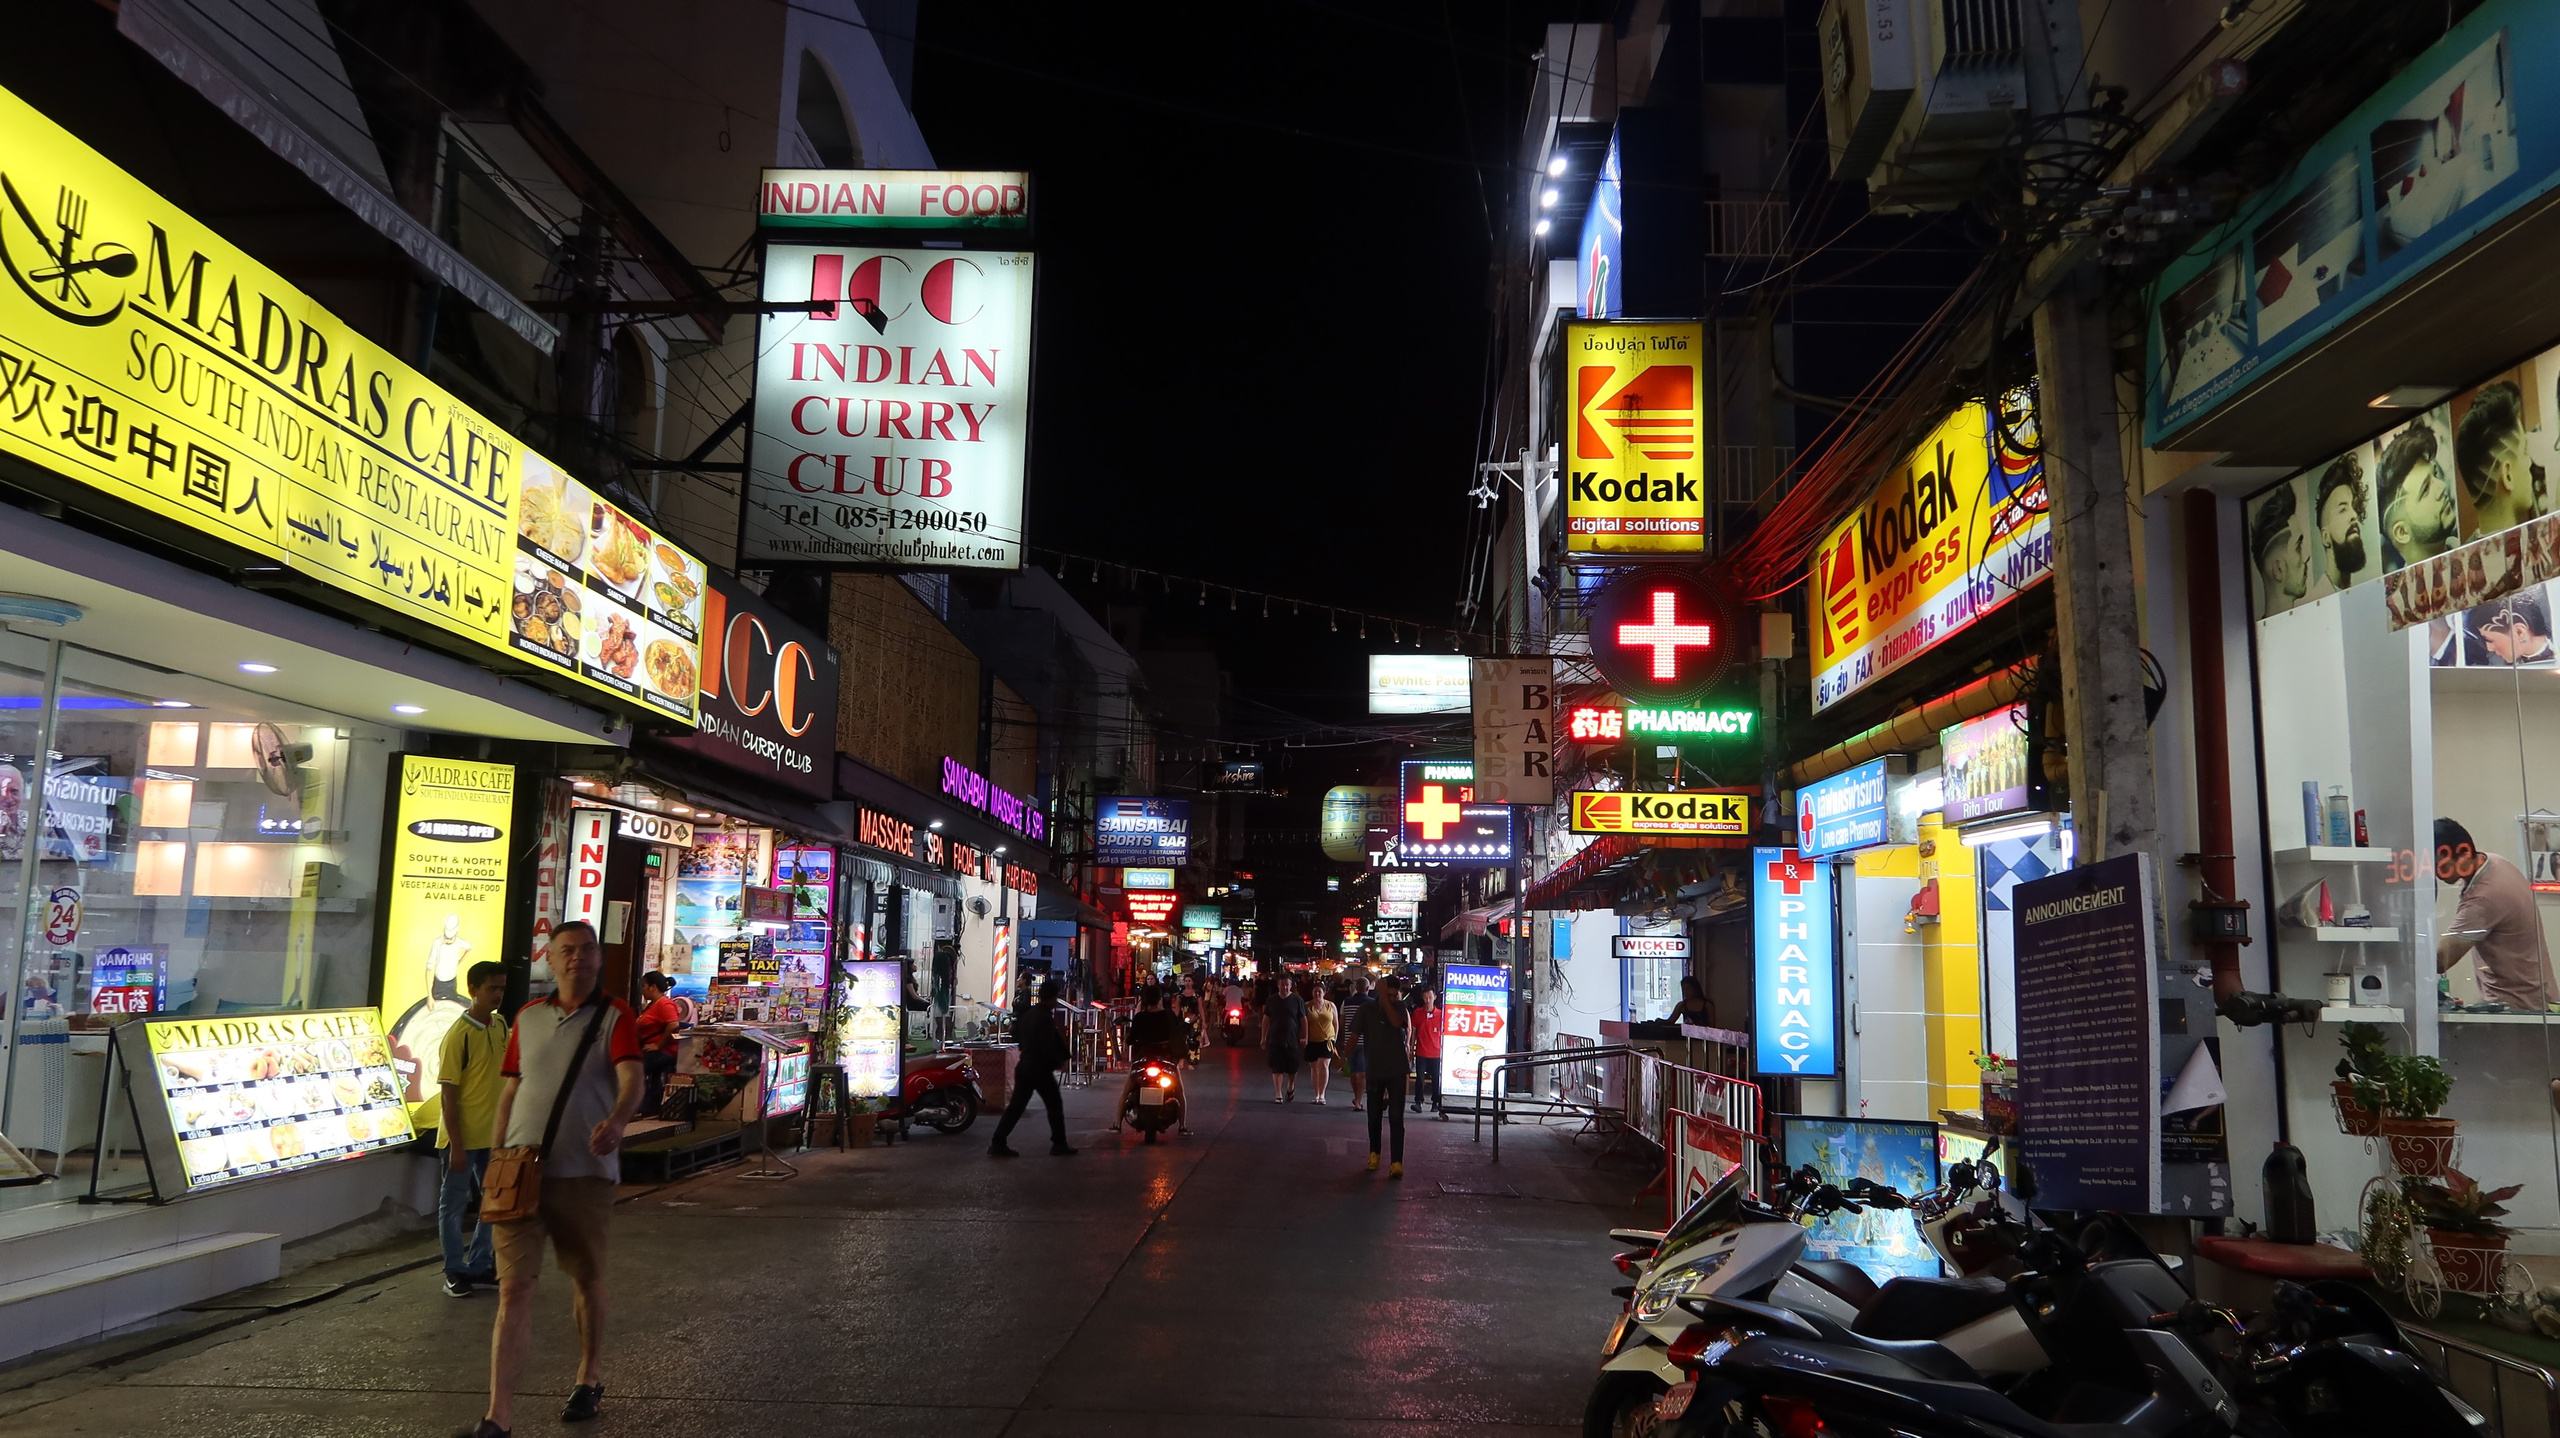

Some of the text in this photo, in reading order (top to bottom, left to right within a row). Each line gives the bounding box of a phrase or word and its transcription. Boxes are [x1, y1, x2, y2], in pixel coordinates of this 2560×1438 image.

[762, 182, 1026, 217] INDIAN FOOD
[809, 254, 986, 326] ICC
[1583, 333, 1690, 354] ป๊อปปูล่า โฟโต้
[137, 220, 511, 508] MADRAS CAFE
[787, 342, 1001, 389] INDIAN
[790, 395, 997, 443] CURRY
[0, 350, 275, 531] 欢迎中国人
[127, 329, 506, 565] SOUTH INDIAN RESTAURANT
[787, 453, 954, 498] CLUB
[1571, 471, 1699, 502] Kodak
[780, 504, 987, 534] Tel 085-1200050
[1858, 438, 1959, 585] Kodak
[1571, 517, 1700, 534] digital solutions
[768, 535, 1006, 562] www.indiancurryclubphuket.com
[1865, 525, 1960, 623] express
[606, 588, 627, 604] SAMOSA
[519, 638, 540, 653] NORTH
[590, 668, 634, 693] TANDOORI CHICKEN
[1855, 653, 1873, 686] FAX
[1477, 660, 1512, 801] WICKED
[1521, 684, 1550, 778] BAR
[1571, 708, 1624, 739] 药店
[1627, 708, 1753, 734] PHARMACY
[696, 709, 813, 774] NDIAN CURRY CLUB
[422, 766, 512, 790] MADRAS CAFE
[1425, 766, 1473, 780] PHARMA
[420, 788, 511, 805] SOUTH INDIAN RESTAURANT
[942, 755, 990, 812] SANSABAI
[990, 783, 1023, 831] MASSAGE
[1032, 810, 1044, 841] SPA
[1631, 796, 1741, 821] Kodak
[1962, 797, 2004, 819] Rita Tour
[1098, 817, 1188, 834] SANSABAI
[1327, 809, 1359, 823] DIVE
[1671, 822, 1698, 831] digital
[1699, 822, 1740, 831] solutions
[418, 822, 495, 839] 24 HOURS OPEN
[859, 807, 915, 858] MASSAGE
[926, 831, 945, 867] SPA
[953, 841, 978, 877] FACIAL
[1097, 834, 1187, 848] SPORTS BAR
[1821, 818, 1882, 849] Love care Pharmacy
[409, 854, 502, 866] SOUTH & NORTH
[424, 866, 496, 877] INDIAN FOOD
[646, 853, 661, 867] OPEN
[400, 881, 450, 890] VEGETARIAN
[460, 883, 478, 891] JAIN
[480, 884, 501, 892] FOOD
[1143, 875, 1166, 886] PADI
[425, 892, 486, 902] AVAILABLE
[2025, 885, 2126, 924] ANNOUNCEMENT
[50, 904, 75, 931] 24
[1183, 910, 1220, 923] EXCHANGE
[1622, 940, 1686, 951] WICKED
[750, 959, 779, 971] TAXI
[1447, 973, 1507, 988] PHARMACY
[1777, 900, 1811, 1072] PHARMACY
[174, 1015, 364, 1049] MADRAS CAFE
[1447, 1008, 1498, 1034] 药店
[1904, 1125, 1934, 1137] SHOW
[2178, 1136, 2192, 1144] 12th
[2192, 1136, 2219, 1145] February
